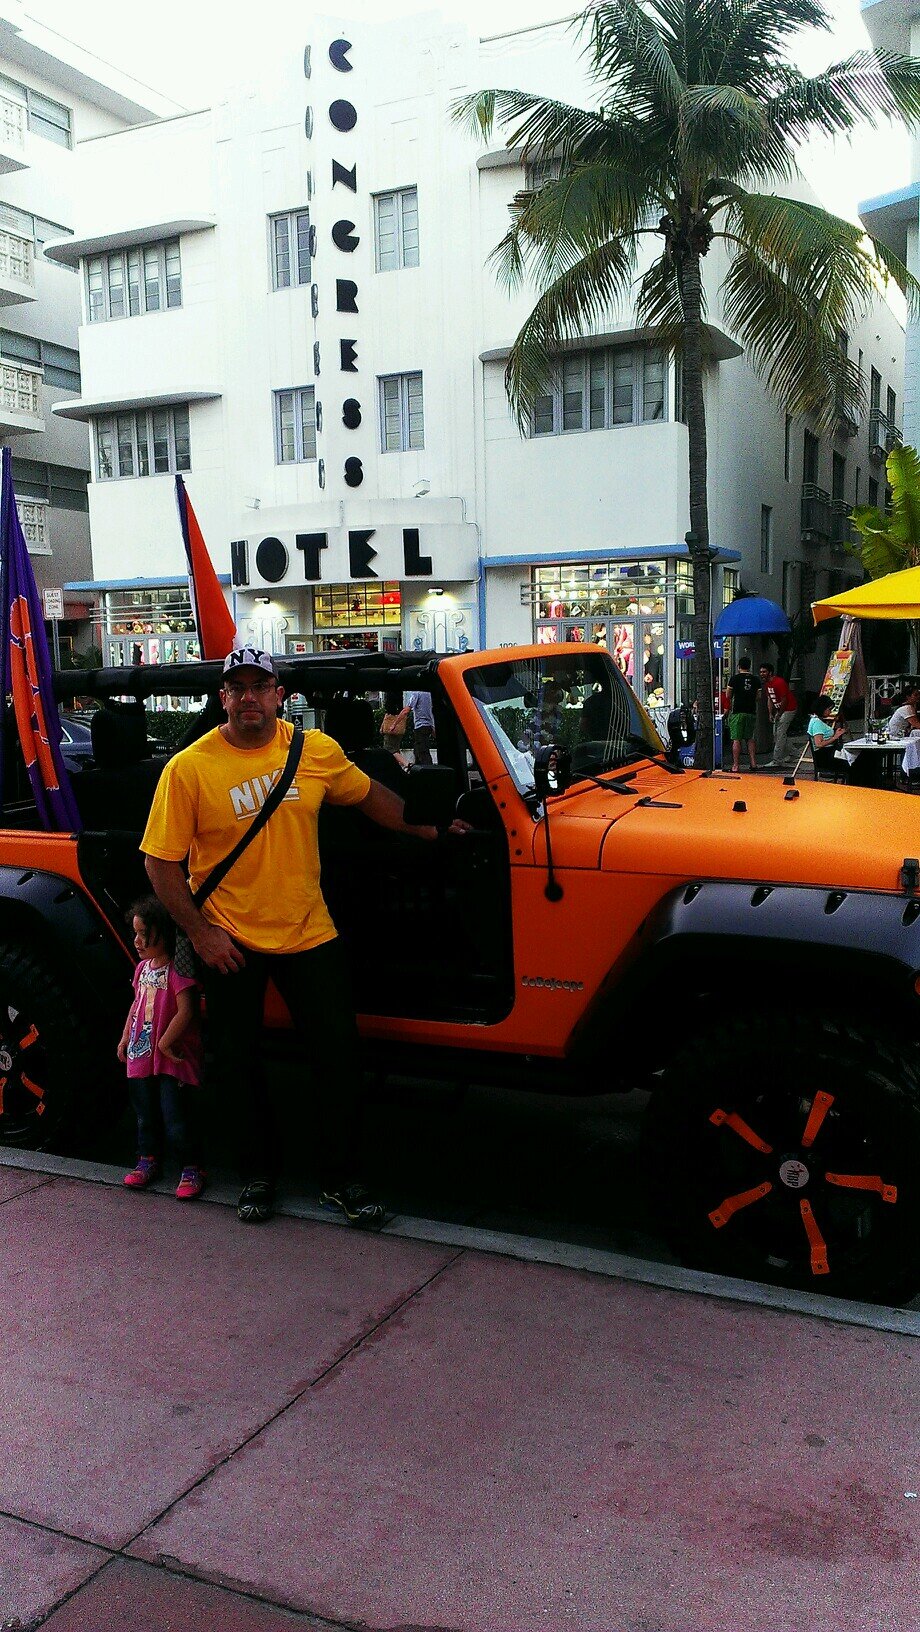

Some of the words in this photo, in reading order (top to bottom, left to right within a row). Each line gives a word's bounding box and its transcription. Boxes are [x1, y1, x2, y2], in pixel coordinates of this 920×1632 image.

[328, 38, 363, 488] CONGRESS
[230, 527, 433, 587] HOTEL
[229, 648, 264, 668] NY
[743, 678, 752, 691] 5
[229, 768, 299, 816] NIK
